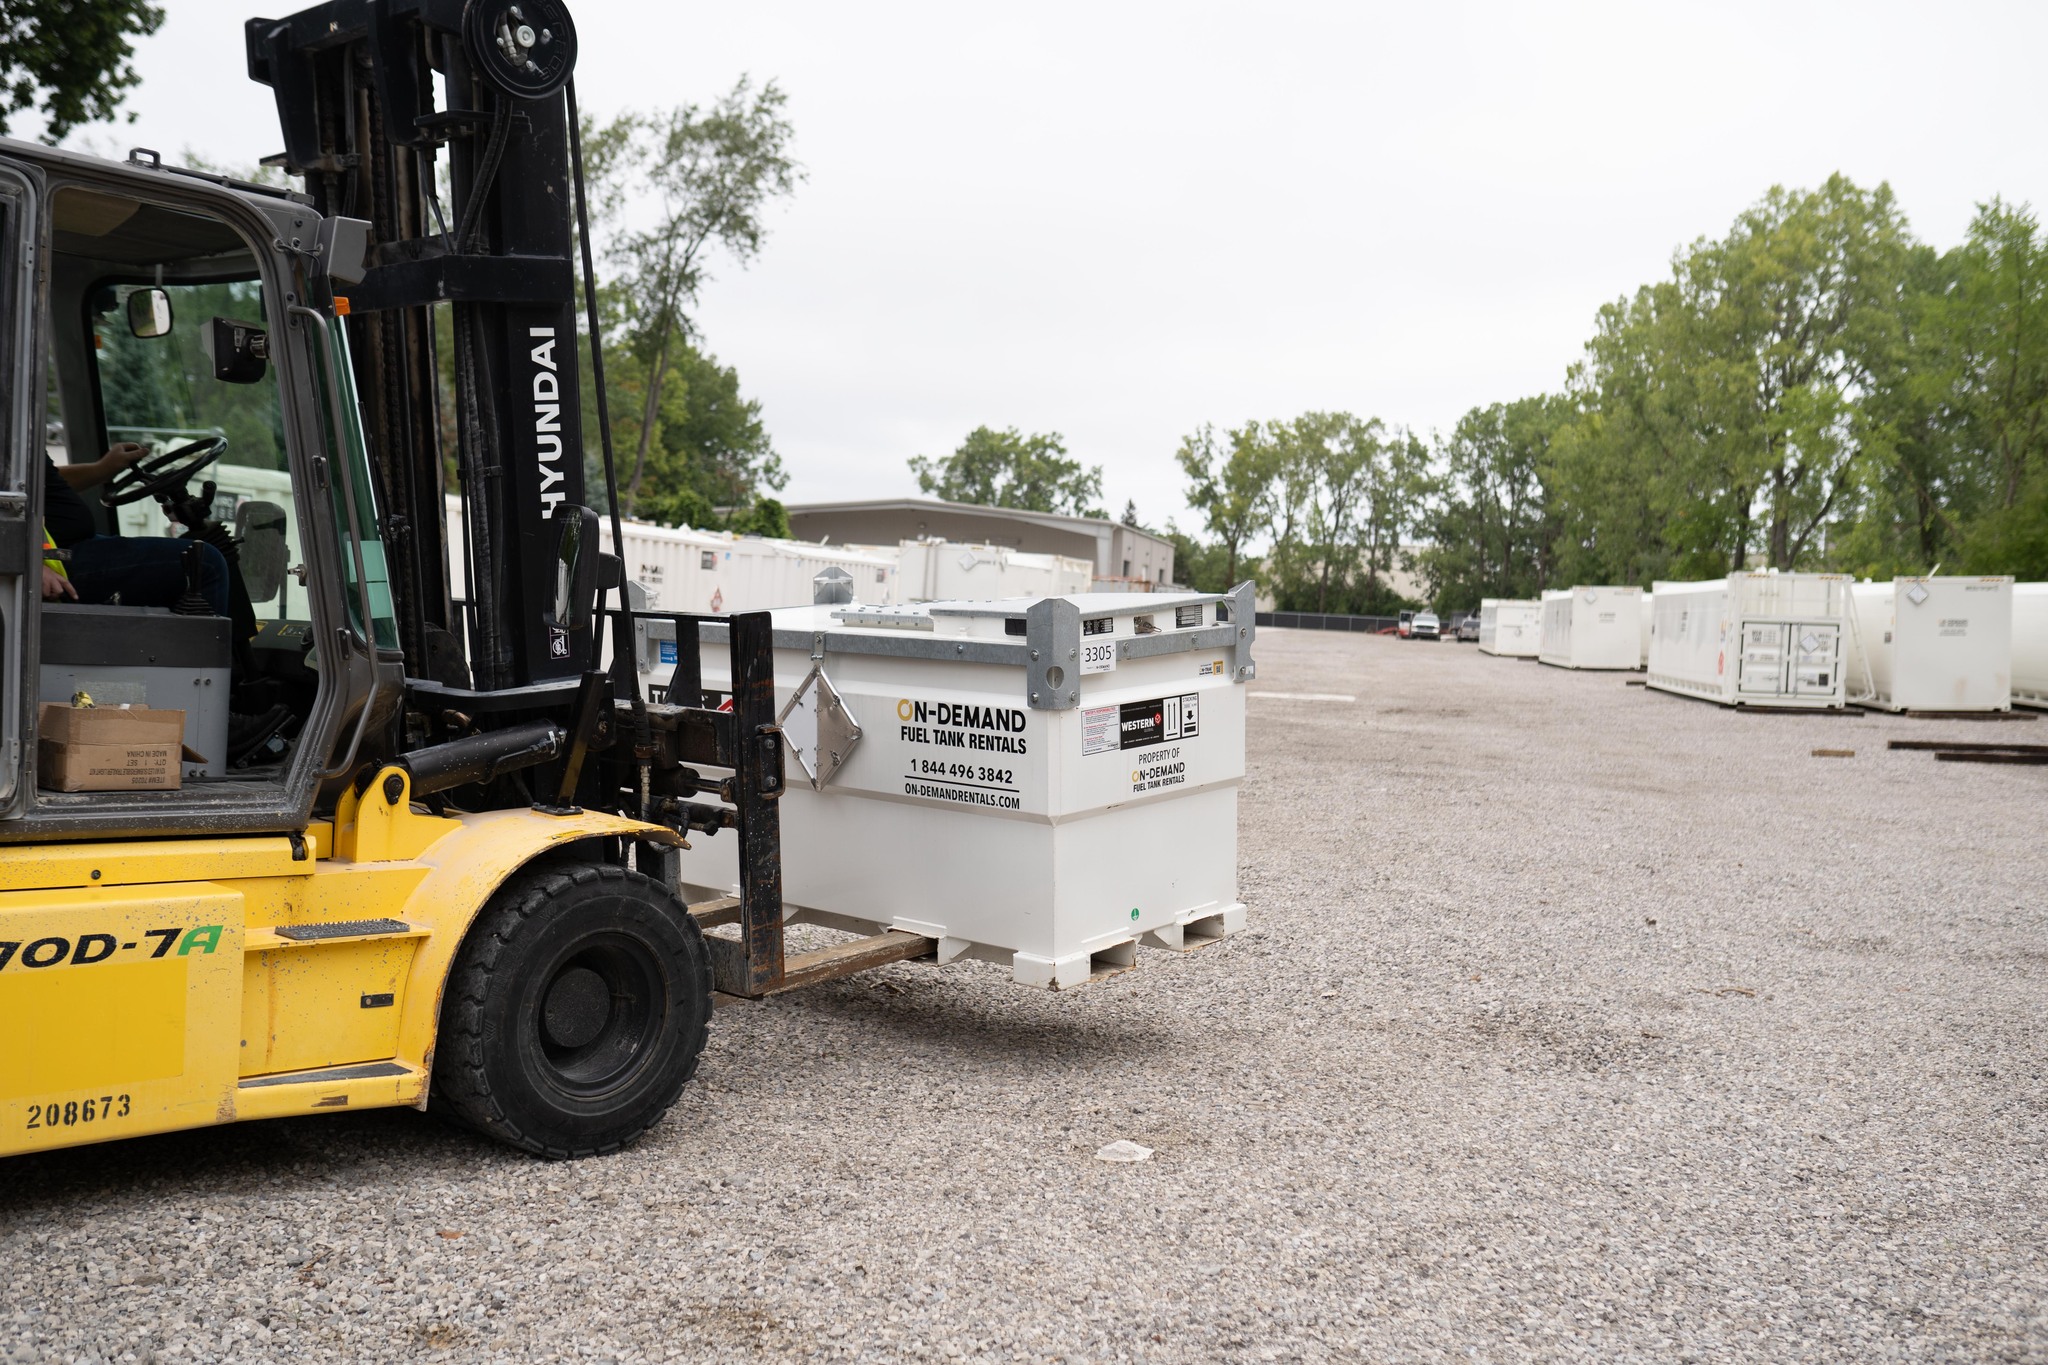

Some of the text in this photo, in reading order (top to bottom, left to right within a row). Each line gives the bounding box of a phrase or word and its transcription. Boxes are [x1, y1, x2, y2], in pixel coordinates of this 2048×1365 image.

[529, 327, 566, 519] HYUNDAI
[1085, 645, 1112, 662] 3305
[897, 698, 1026, 733] ON-DEMAND
[1121, 717, 1154, 732] WESTERN
[901, 725, 1027, 755] FUEL TANK RENTALS
[1138, 747, 1180, 765] PROPERTY OF
[910, 758, 1013, 784] 1 844 496 3842
[1131, 762, 1186, 783] ON-DEMAND
[1133, 774, 1185, 793] FUEL TANK RENTALS
[904, 782, 1020, 810] ON-DEMANDRENTALS.COM
[26, 1094, 131, 1130] 208673
